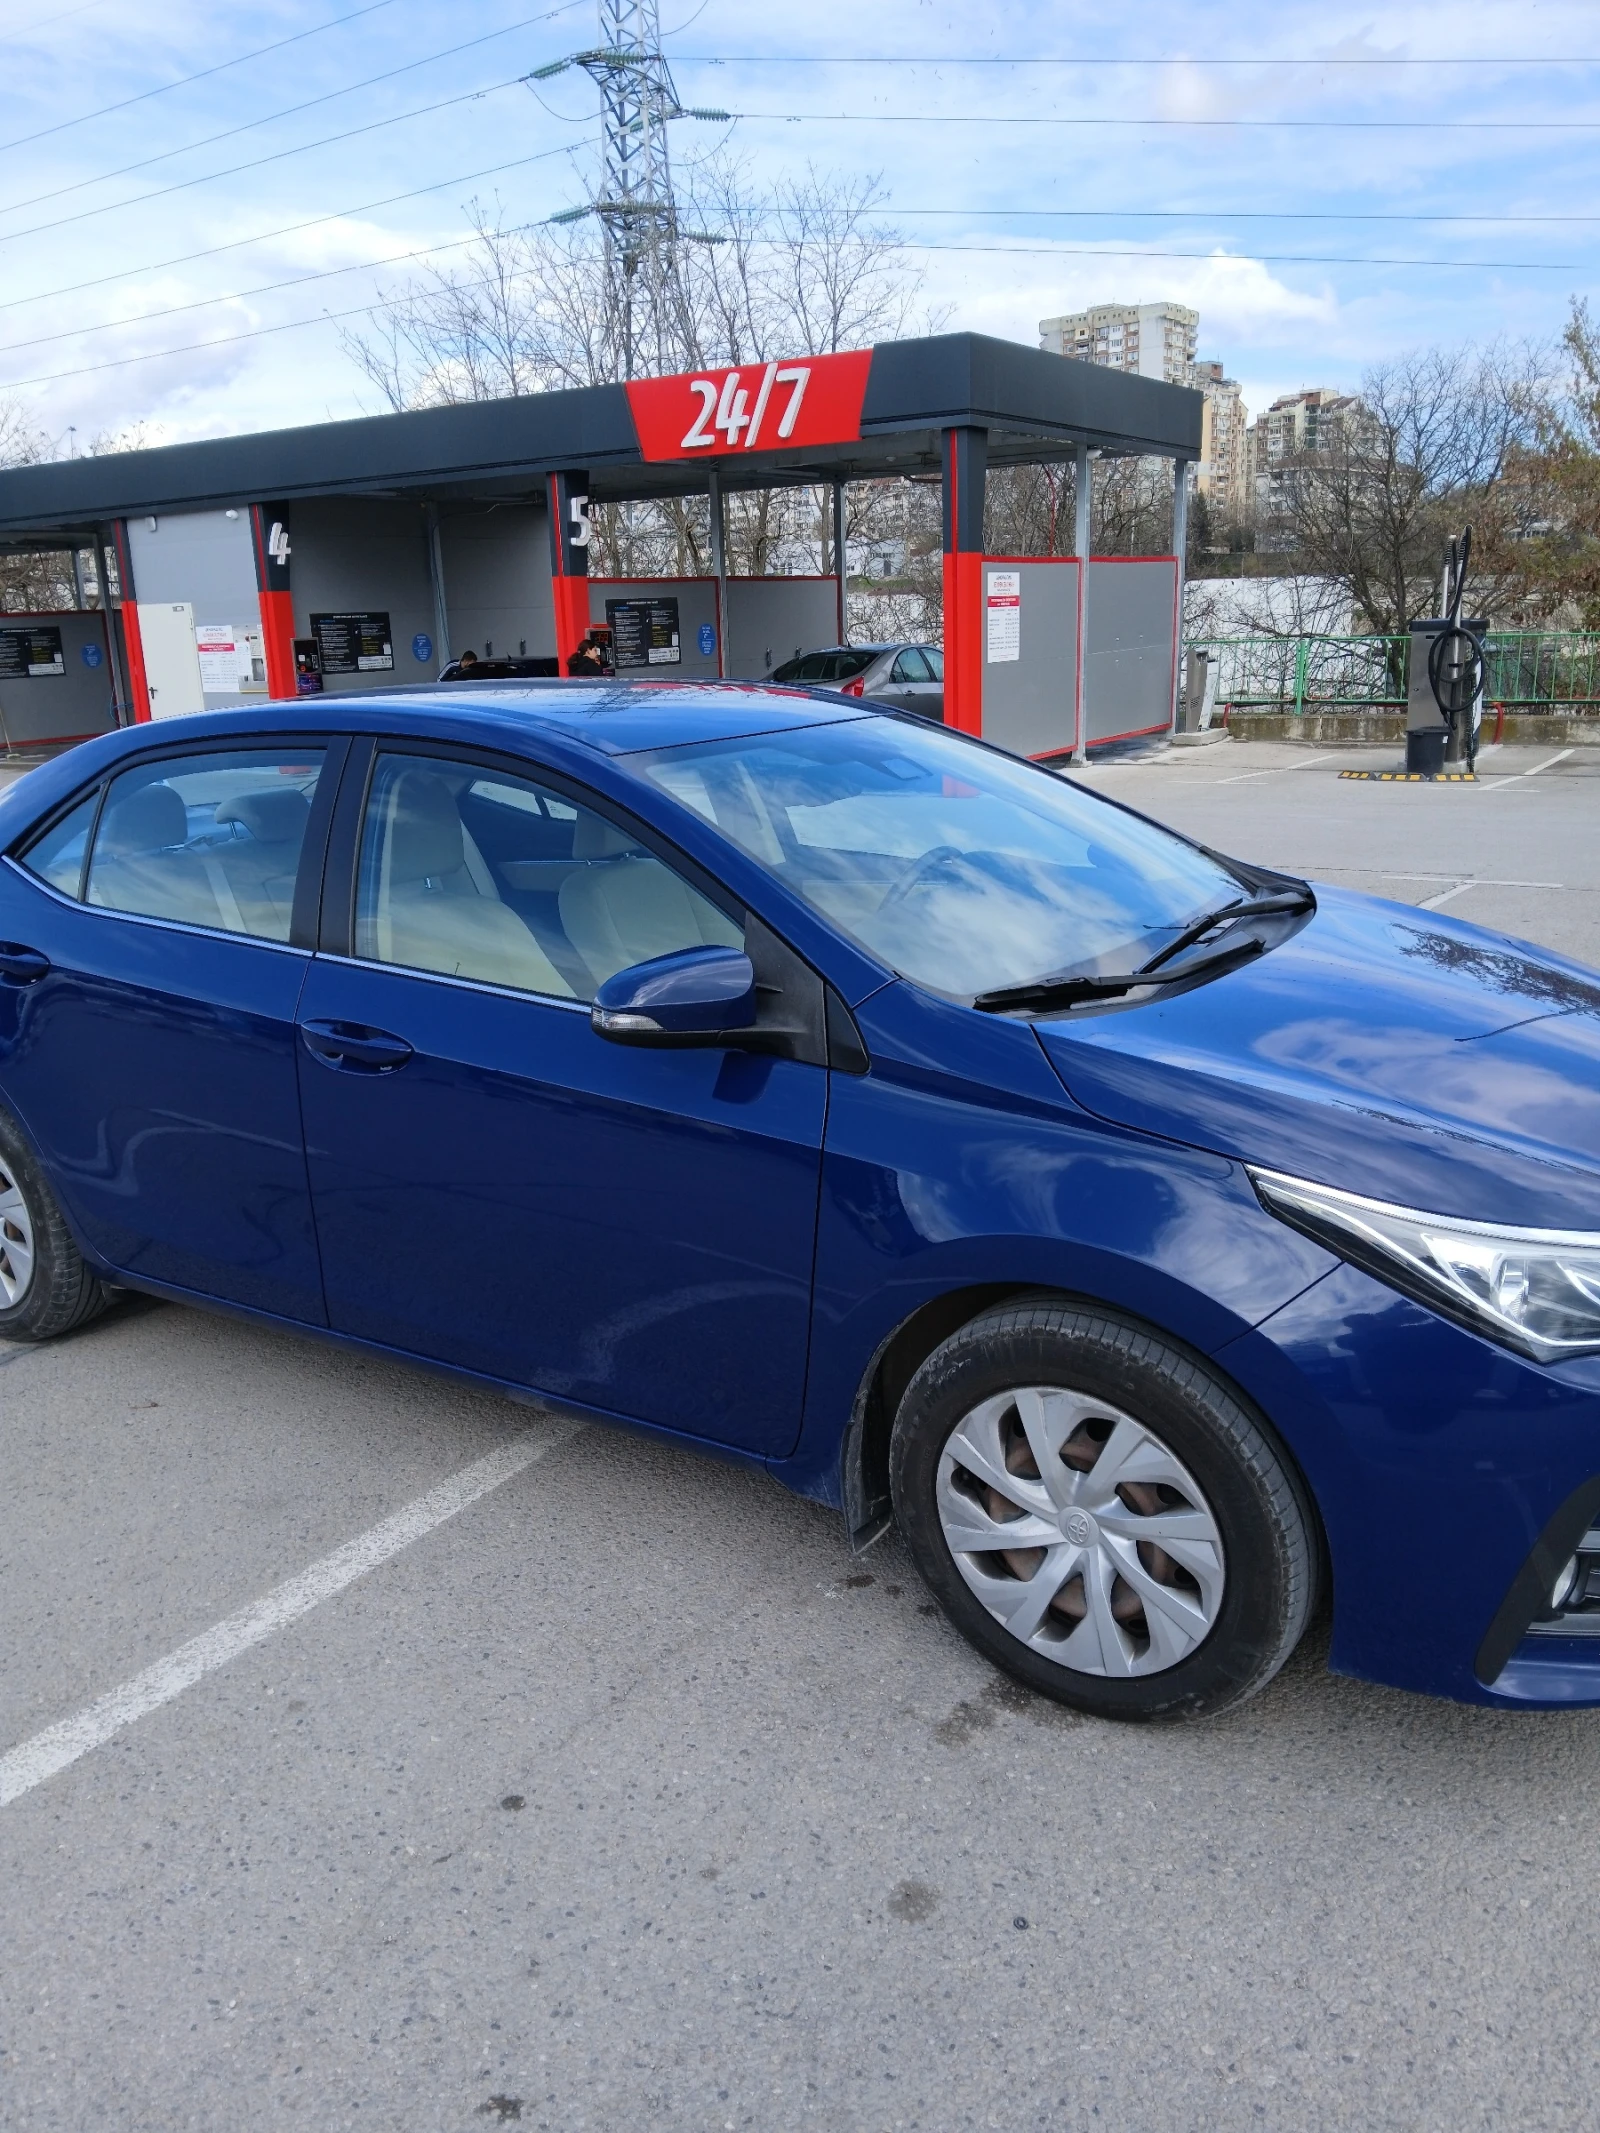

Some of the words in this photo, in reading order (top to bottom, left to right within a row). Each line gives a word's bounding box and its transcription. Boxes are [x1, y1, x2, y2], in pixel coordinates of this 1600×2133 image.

[681, 363, 810, 447] 24/7
[268, 522, 291, 565] 4
[570, 496, 591, 546] 5
